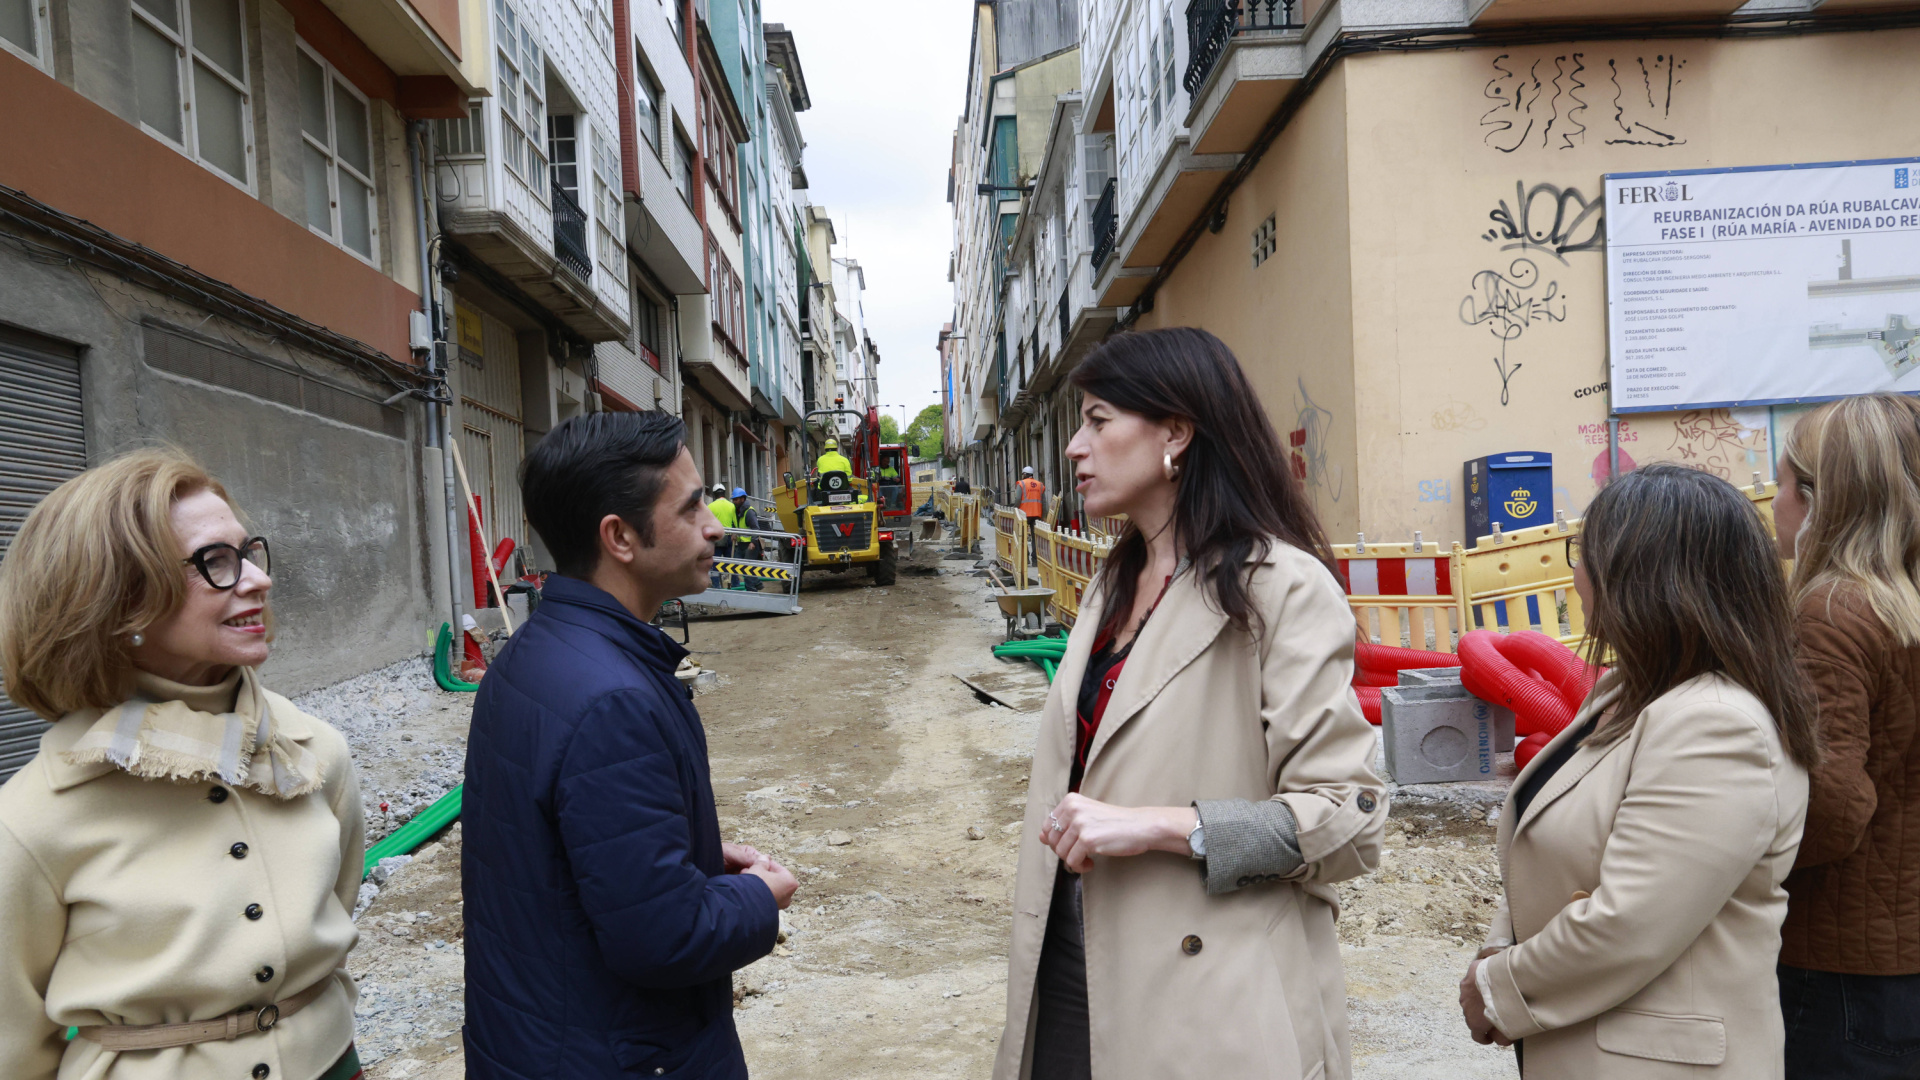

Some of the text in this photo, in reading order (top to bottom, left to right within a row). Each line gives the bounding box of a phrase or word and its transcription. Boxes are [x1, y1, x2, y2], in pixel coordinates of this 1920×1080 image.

[1653, 197, 1920, 224] REURBANIZACIÓN DA RÚA RUBALCAV
[1661, 227, 1697, 241] FASE
[1711, 221, 1748, 241] (RÚA
[1751, 219, 1797, 236] MARÍA
[1808, 217, 1869, 232] AVENIDA
[1871, 215, 1896, 228] DO
[1900, 213, 1920, 227] RE
